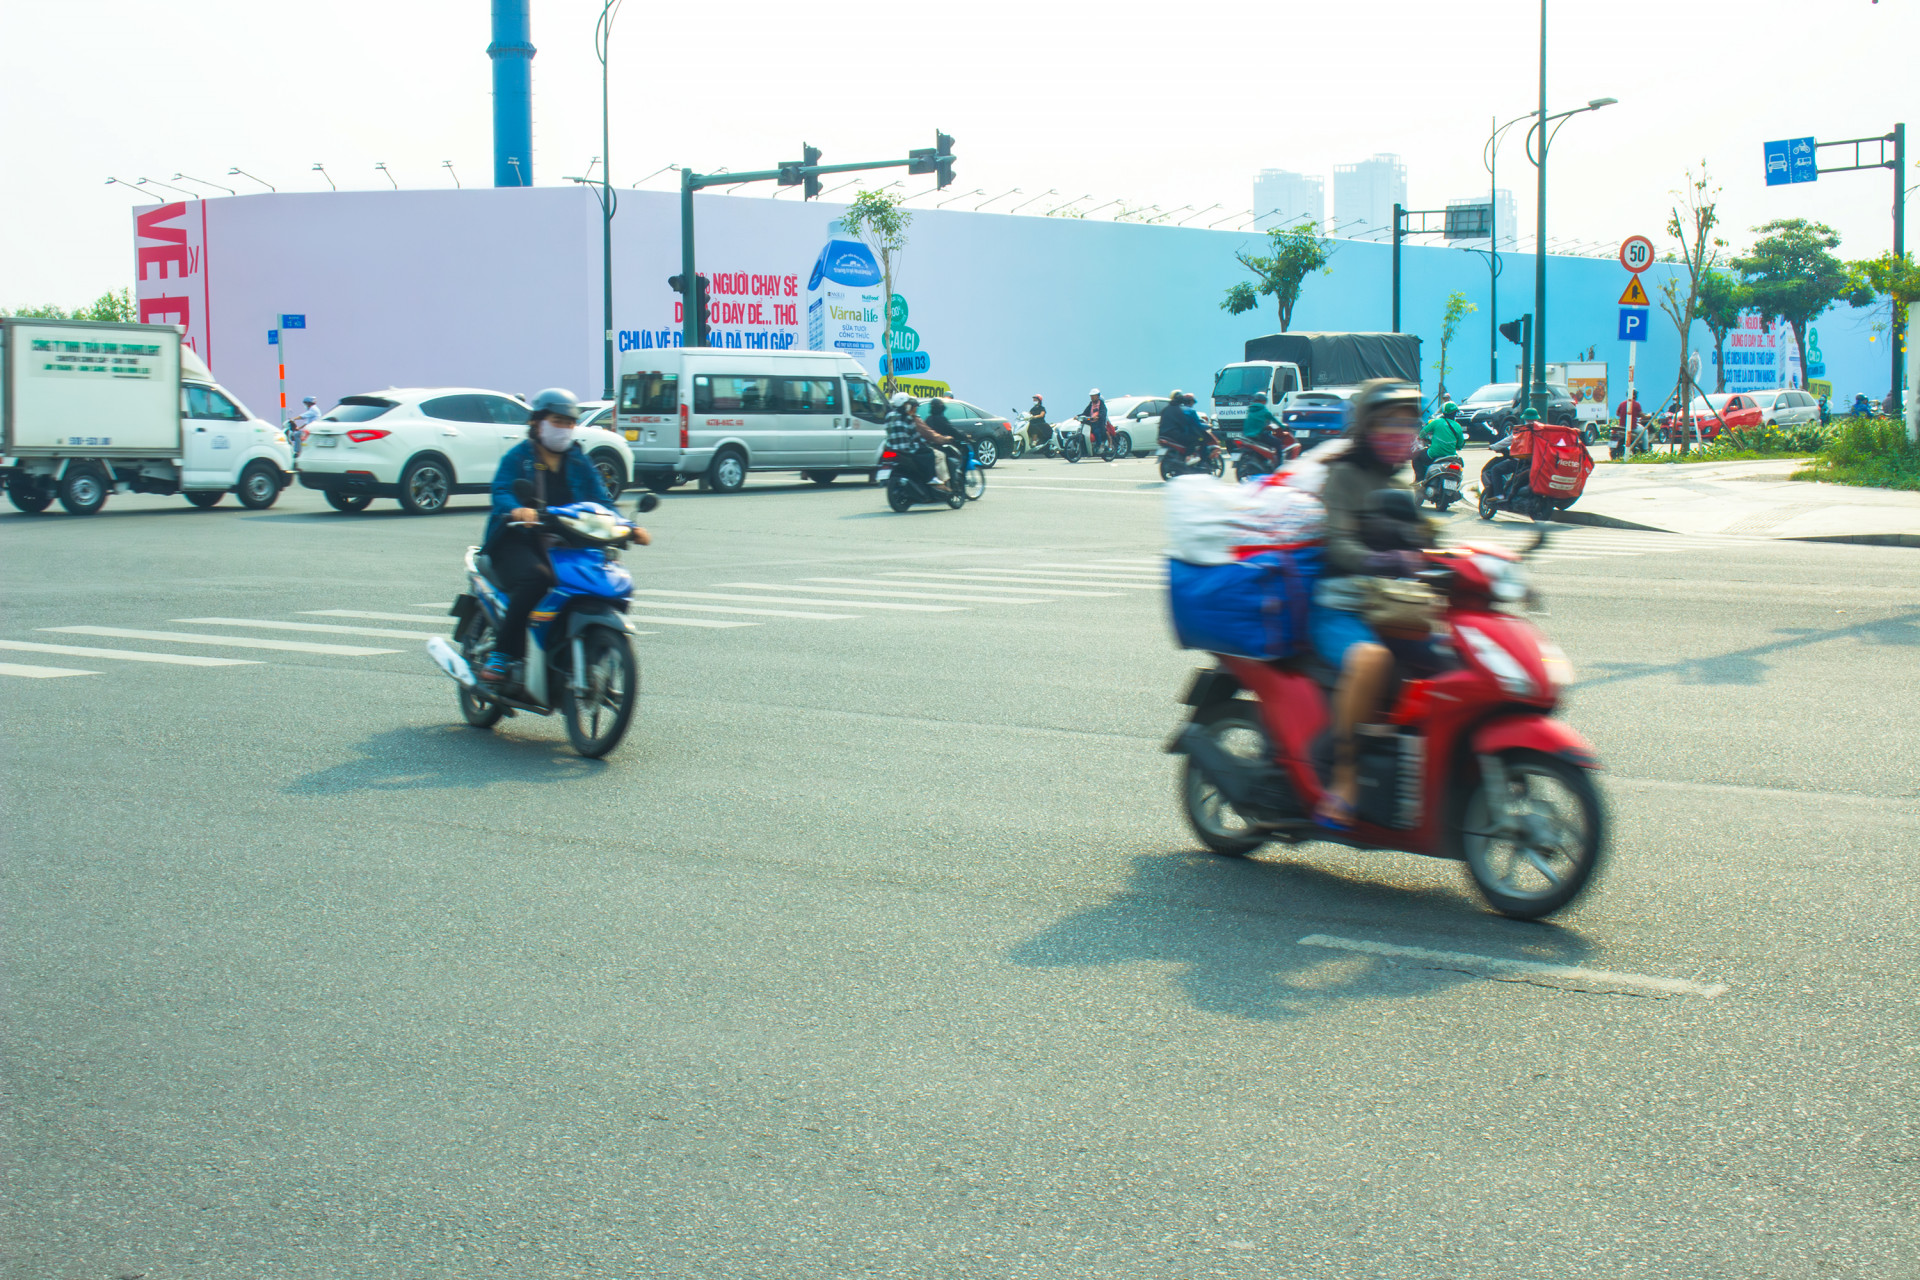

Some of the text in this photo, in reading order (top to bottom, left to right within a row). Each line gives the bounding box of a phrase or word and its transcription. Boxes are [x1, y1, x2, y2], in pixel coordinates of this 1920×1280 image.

[137, 201, 200, 281] VỀ
[1629, 245, 1646, 262] 50
[713, 270, 749, 295] NGƯỜI
[751, 274, 781, 299] CHẠY
[783, 273, 798, 297] SẼ
[722, 300, 745, 325] ĐÂY
[829, 305, 862, 322] Värna
[863, 307, 879, 323] life
[1626, 315, 1640, 334] P
[889, 330, 915, 351] CALCI
[883, 355, 926, 373] VTAMIN D3
[1557, 459, 1580, 468] iette
